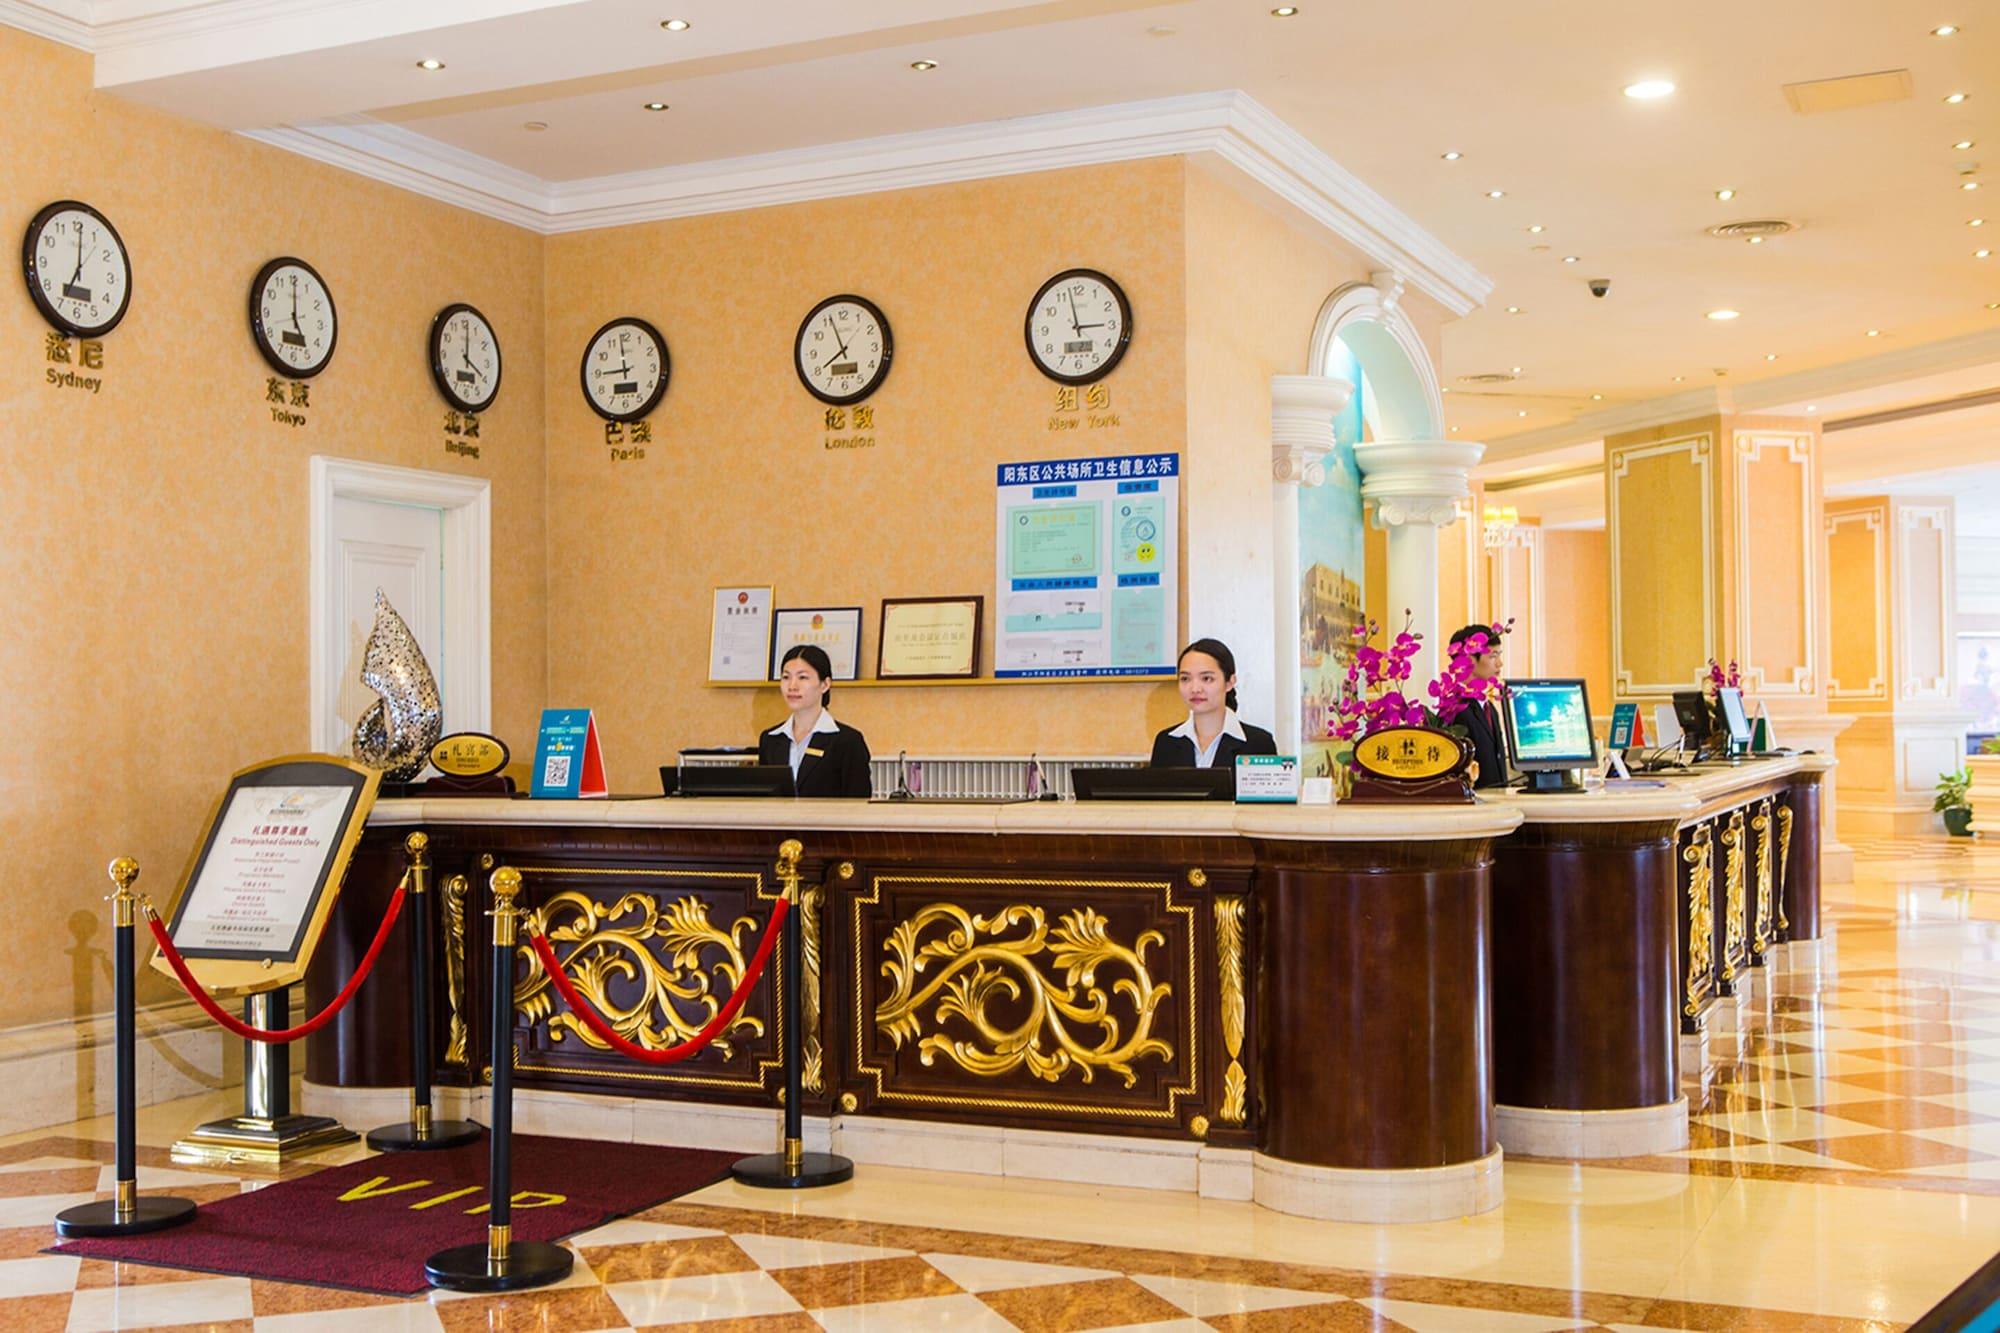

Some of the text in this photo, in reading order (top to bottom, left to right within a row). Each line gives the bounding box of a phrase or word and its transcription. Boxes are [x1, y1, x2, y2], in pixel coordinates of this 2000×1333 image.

[56, 222, 65, 235] 11
[44, 235, 55, 248] 10
[102, 249, 111, 262] 2
[39, 256, 47, 268] 9
[107, 272, 114, 284] 3
[275, 276, 284, 288] 11
[43, 279, 51, 291] 8
[267, 289, 276, 300] 10
[1073, 285, 1085, 296] 12
[102, 292, 110, 304] 4
[1057, 292, 1066, 302] 11
[57, 297, 64, 309] 7
[313, 300, 321, 311] 2
[1104, 301, 1112, 312] 2
[73, 307, 81, 319] 6
[90, 305, 98, 317] 5
[263, 307, 270, 318] 9
[838, 310, 849, 320] 12
[1046, 307, 1056, 317] 10
[317, 320, 324, 331] 3
[867, 324, 874, 335] 2
[1108, 320, 1116, 330] 3
[267, 327, 273, 338] 8
[814, 331, 824, 341] 10
[1041, 326, 1049, 336] 9
[314, 338, 320, 348] 4
[608, 339, 616, 348] 11
[871, 342, 878, 352] 3
[1104, 339, 1112, 348] 4
[278, 343, 284, 354] 7
[647, 347, 654, 357] 2
[1046, 344, 1054, 353] 8
[290, 352, 297, 362] 6
[304, 350, 311, 360] 5
[599, 351, 608, 361] 10
[810, 349, 817, 359] 9
[1092, 353, 1099, 363] 5
[868, 360, 874, 369] 4
[1059, 356, 1066, 366] 7
[1075, 359, 1082, 369] 6
[650, 363, 656, 373] 3
[815, 367, 821, 376] 8
[594, 369, 601, 378] 9
[46, 368, 102, 394] Sydney
[647, 380, 653, 389] 4
[826, 377, 833, 387] 7
[857, 375, 864, 384] 5
[598, 385, 605, 395] 8
[841, 380, 848, 390] 6
[265, 377, 310, 408] 东京
[609, 396, 615, 405] 7
[636, 394, 643, 403] 5
[1056, 384, 1110, 412] 纽约
[622, 399, 629, 408] 6
[270, 407, 306, 428] Tokyo
[825, 405, 874, 431] 伦敦
[1048, 413, 1120, 431] New York
[825, 436, 876, 450] London
[445, 440, 480, 459] Beijing
[611, 447, 645, 462] Paris
[1003, 457, 1172, 483] 阳东区公共场所卫生信息公示
[230, 837, 320, 847] Distinguished Guests Only
[336, 1175, 567, 1215] VIP
